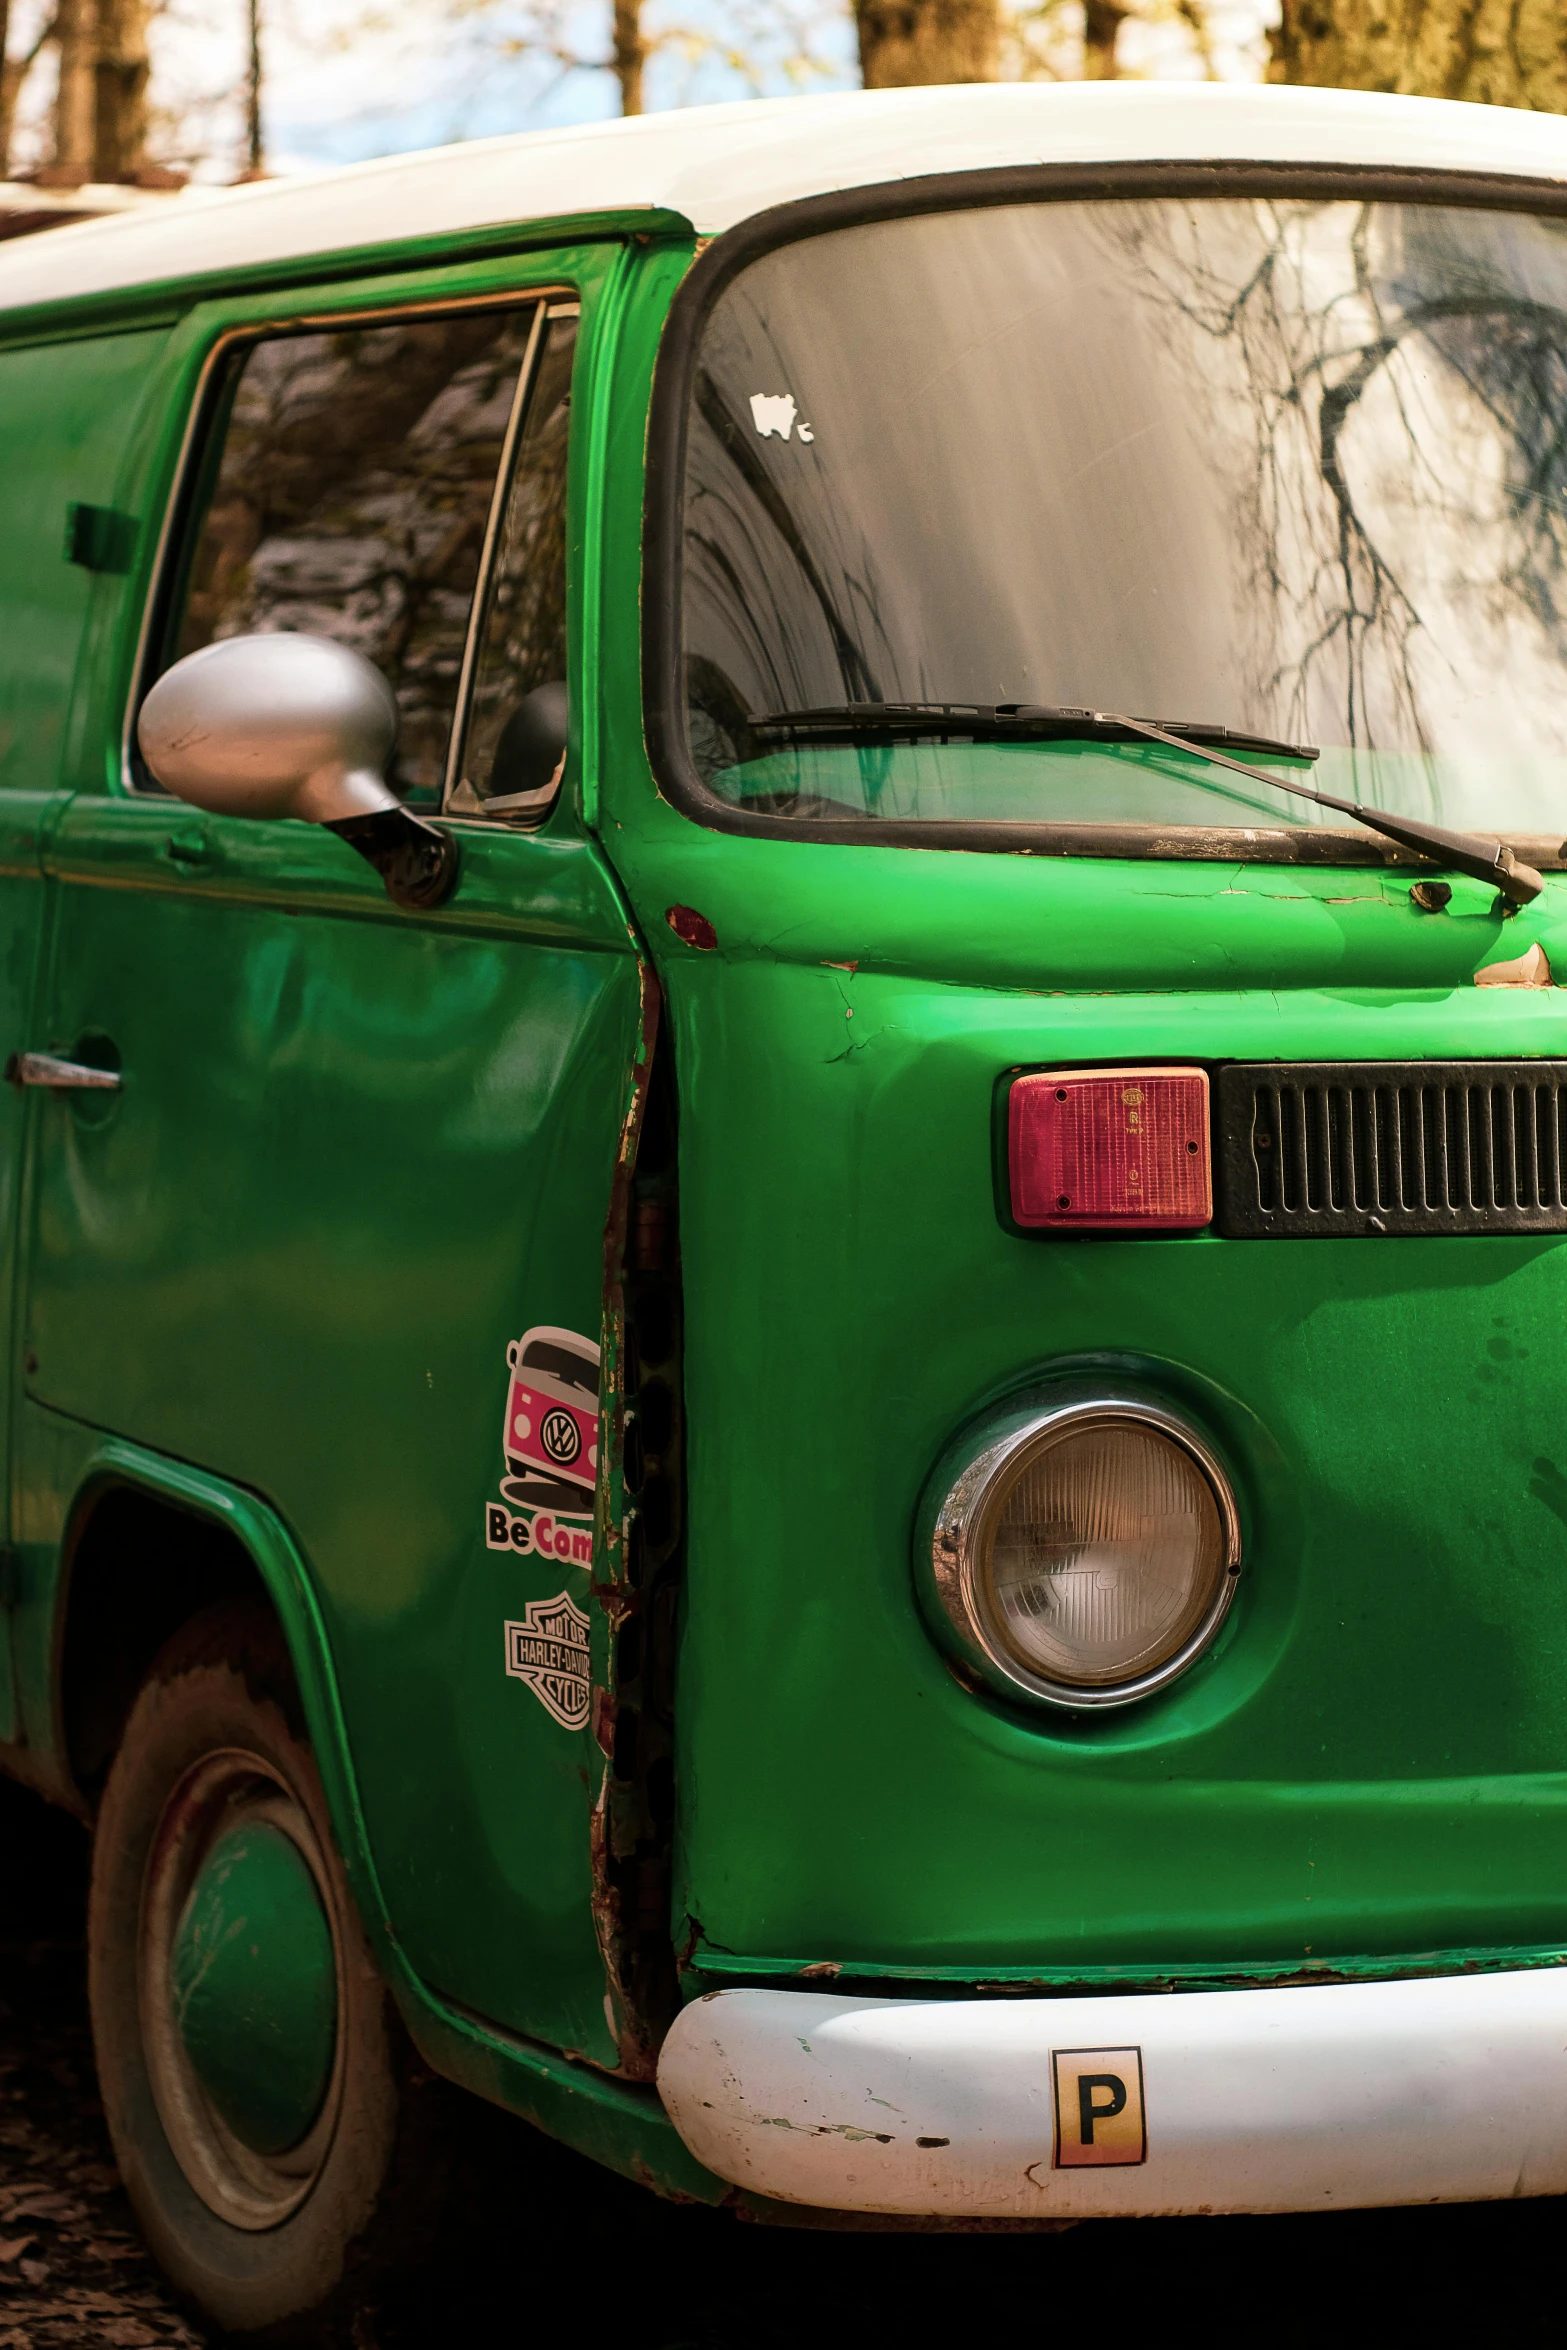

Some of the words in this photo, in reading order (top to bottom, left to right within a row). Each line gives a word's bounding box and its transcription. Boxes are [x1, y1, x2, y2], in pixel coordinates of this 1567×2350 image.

[545, 1611, 587, 1646] MOTOR
[546, 1675, 586, 1712] CYCLES
[1078, 2074, 1127, 2145] P
